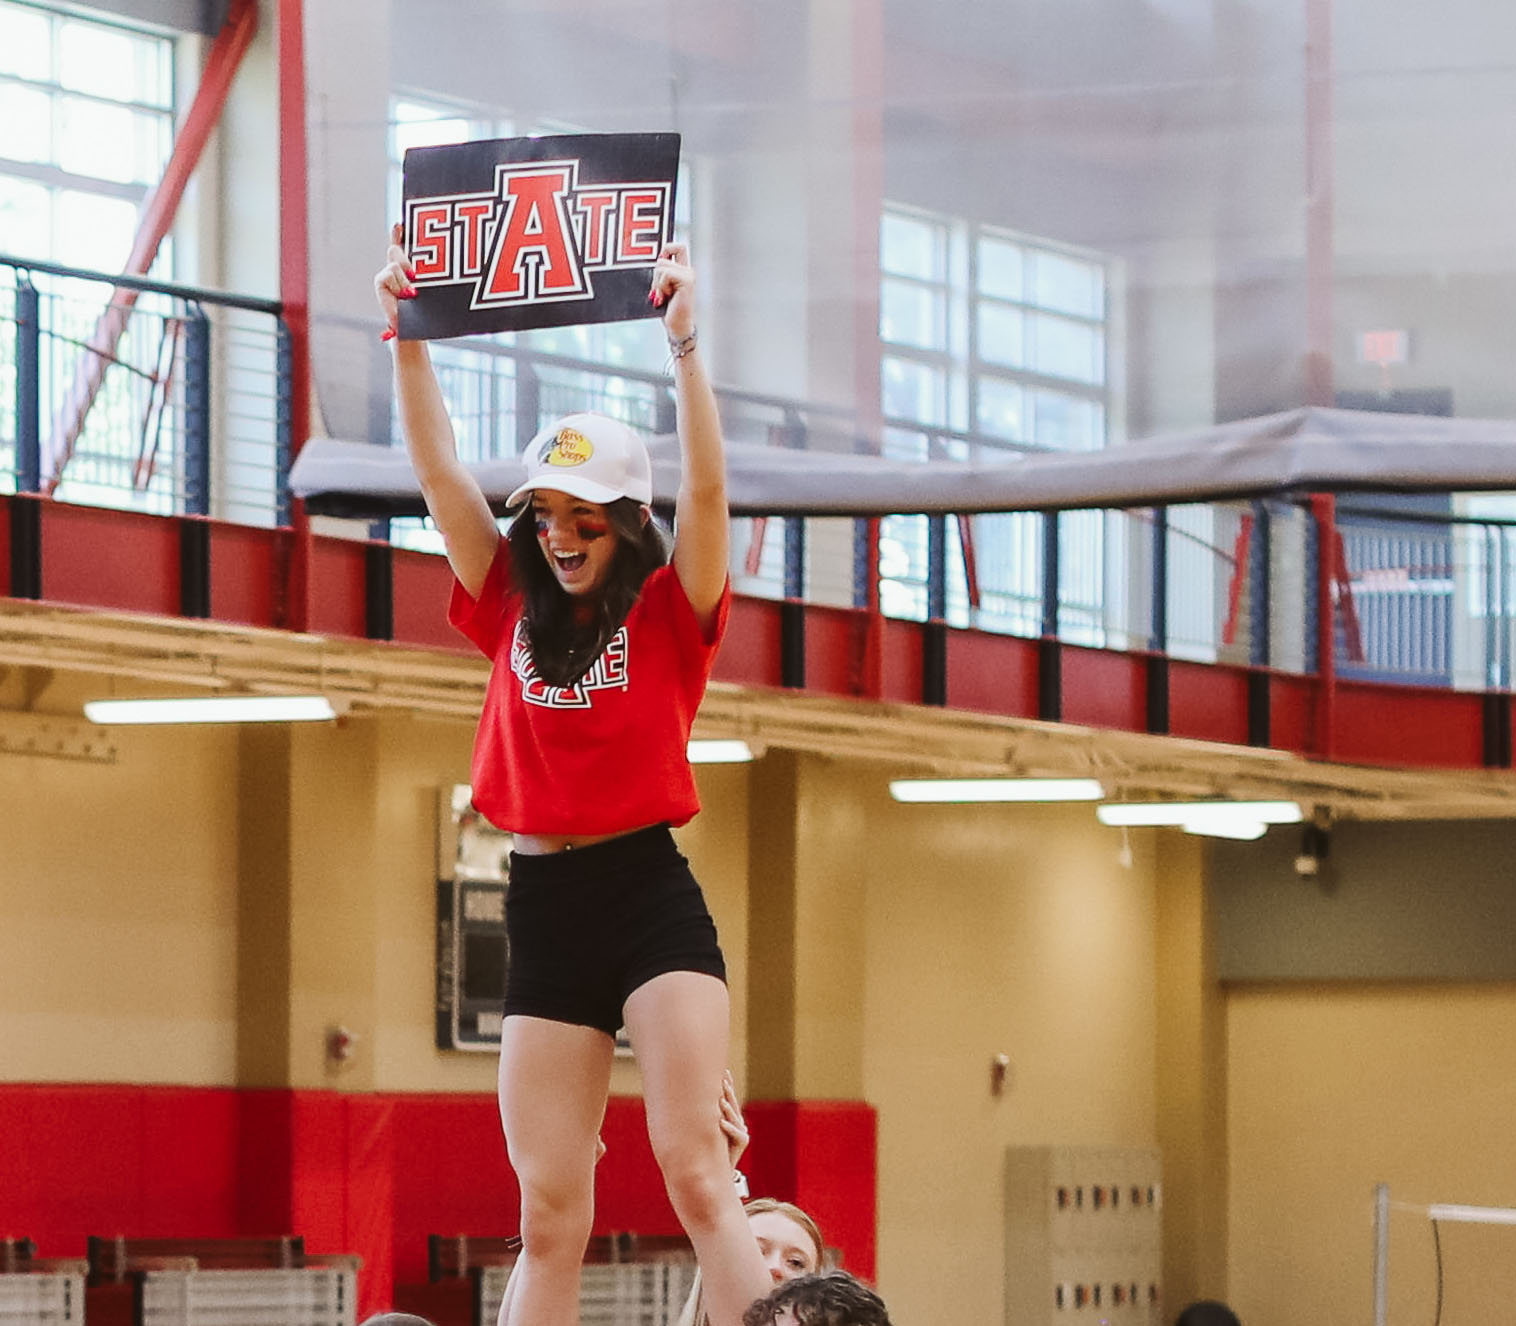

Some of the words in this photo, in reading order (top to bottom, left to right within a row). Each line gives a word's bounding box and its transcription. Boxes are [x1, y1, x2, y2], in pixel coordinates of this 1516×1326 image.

[405, 159, 672, 310] STATE
[559, 430, 584, 442] Bass
[559, 440, 577, 450] Pro
[559, 450, 588, 462] Shops
